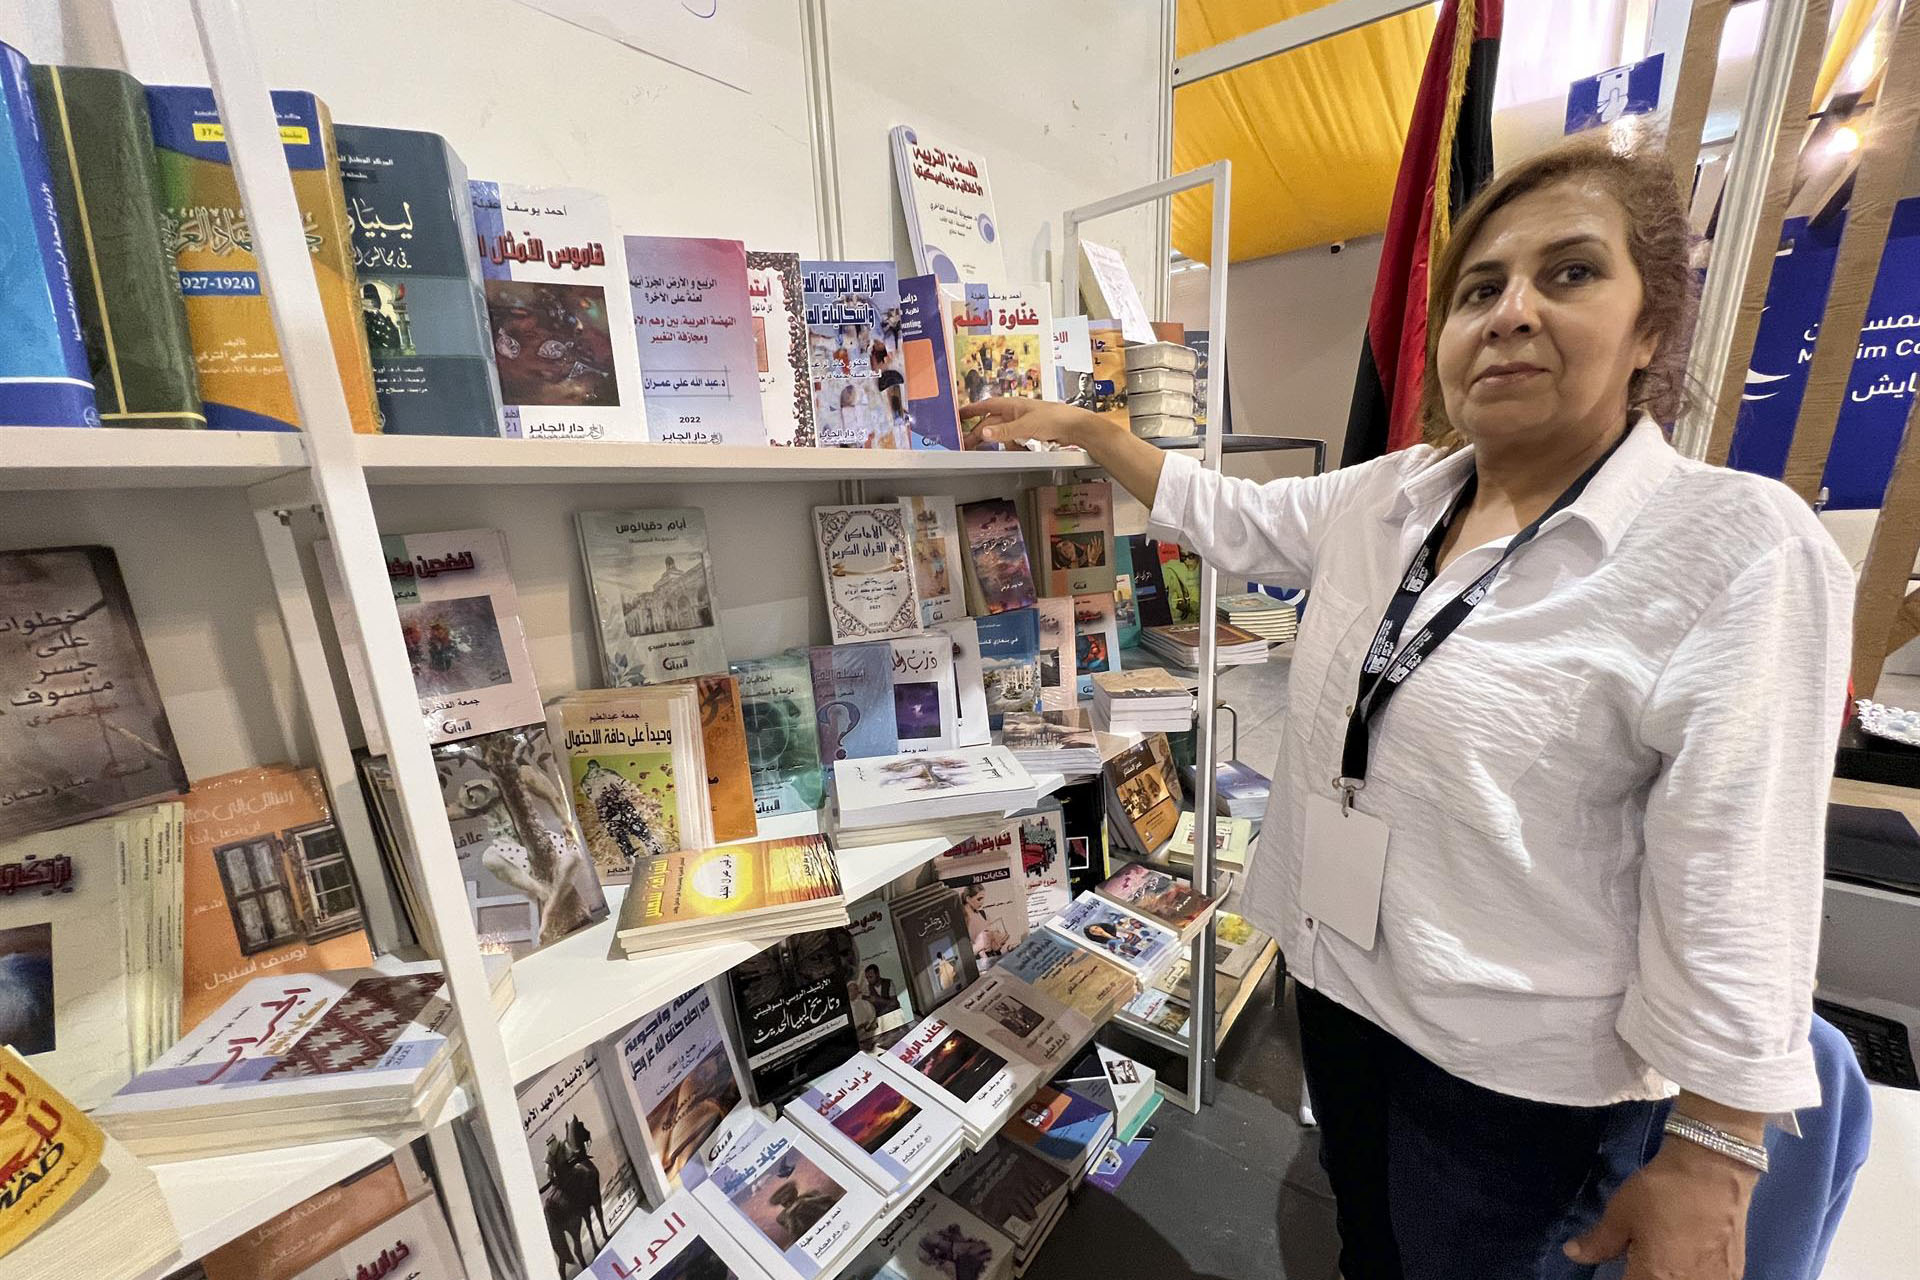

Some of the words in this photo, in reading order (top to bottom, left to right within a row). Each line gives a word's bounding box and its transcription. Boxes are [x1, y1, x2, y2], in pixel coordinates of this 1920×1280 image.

[679, 416, 701, 424] 2022
[667, 517, 687, 530] أيام
[565, 728, 602, 750] الاحتمال
[604, 727, 625, 745] حافة
[628, 728, 645, 747] على
